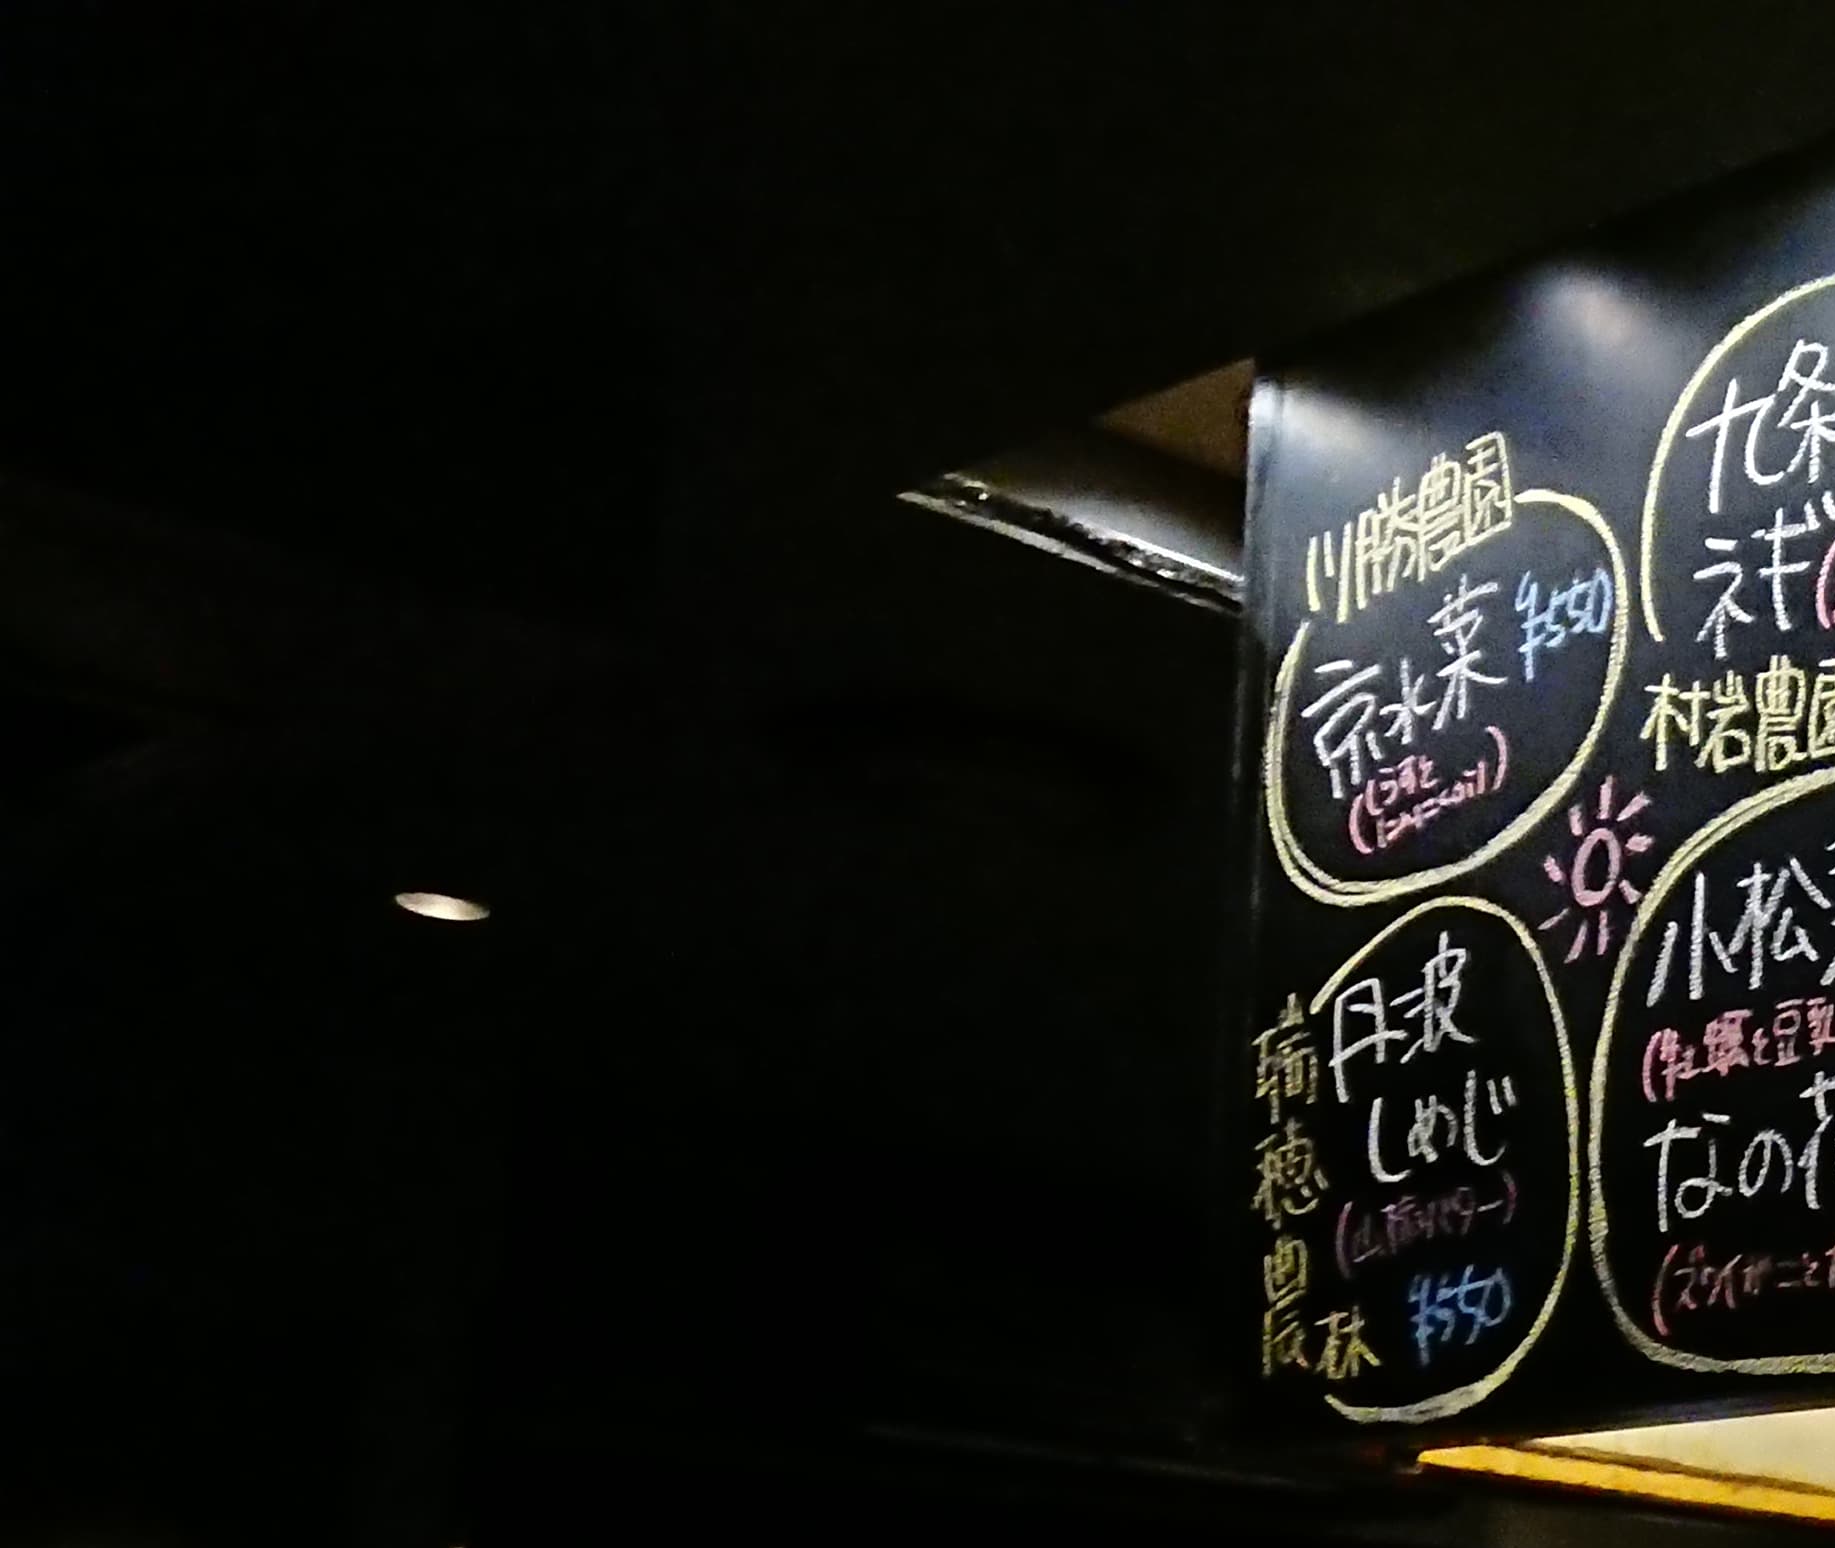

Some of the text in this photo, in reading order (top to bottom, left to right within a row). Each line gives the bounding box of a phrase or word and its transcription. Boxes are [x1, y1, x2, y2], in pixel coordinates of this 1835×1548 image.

[1305, 430, 1514, 624] 川勝農園
[1301, 572, 1507, 800] 京水菜
[1513, 570, 1614, 684] ¥550
[1328, 931, 1477, 1103] 丹波
[1368, 1068, 1516, 1183] しめじ
